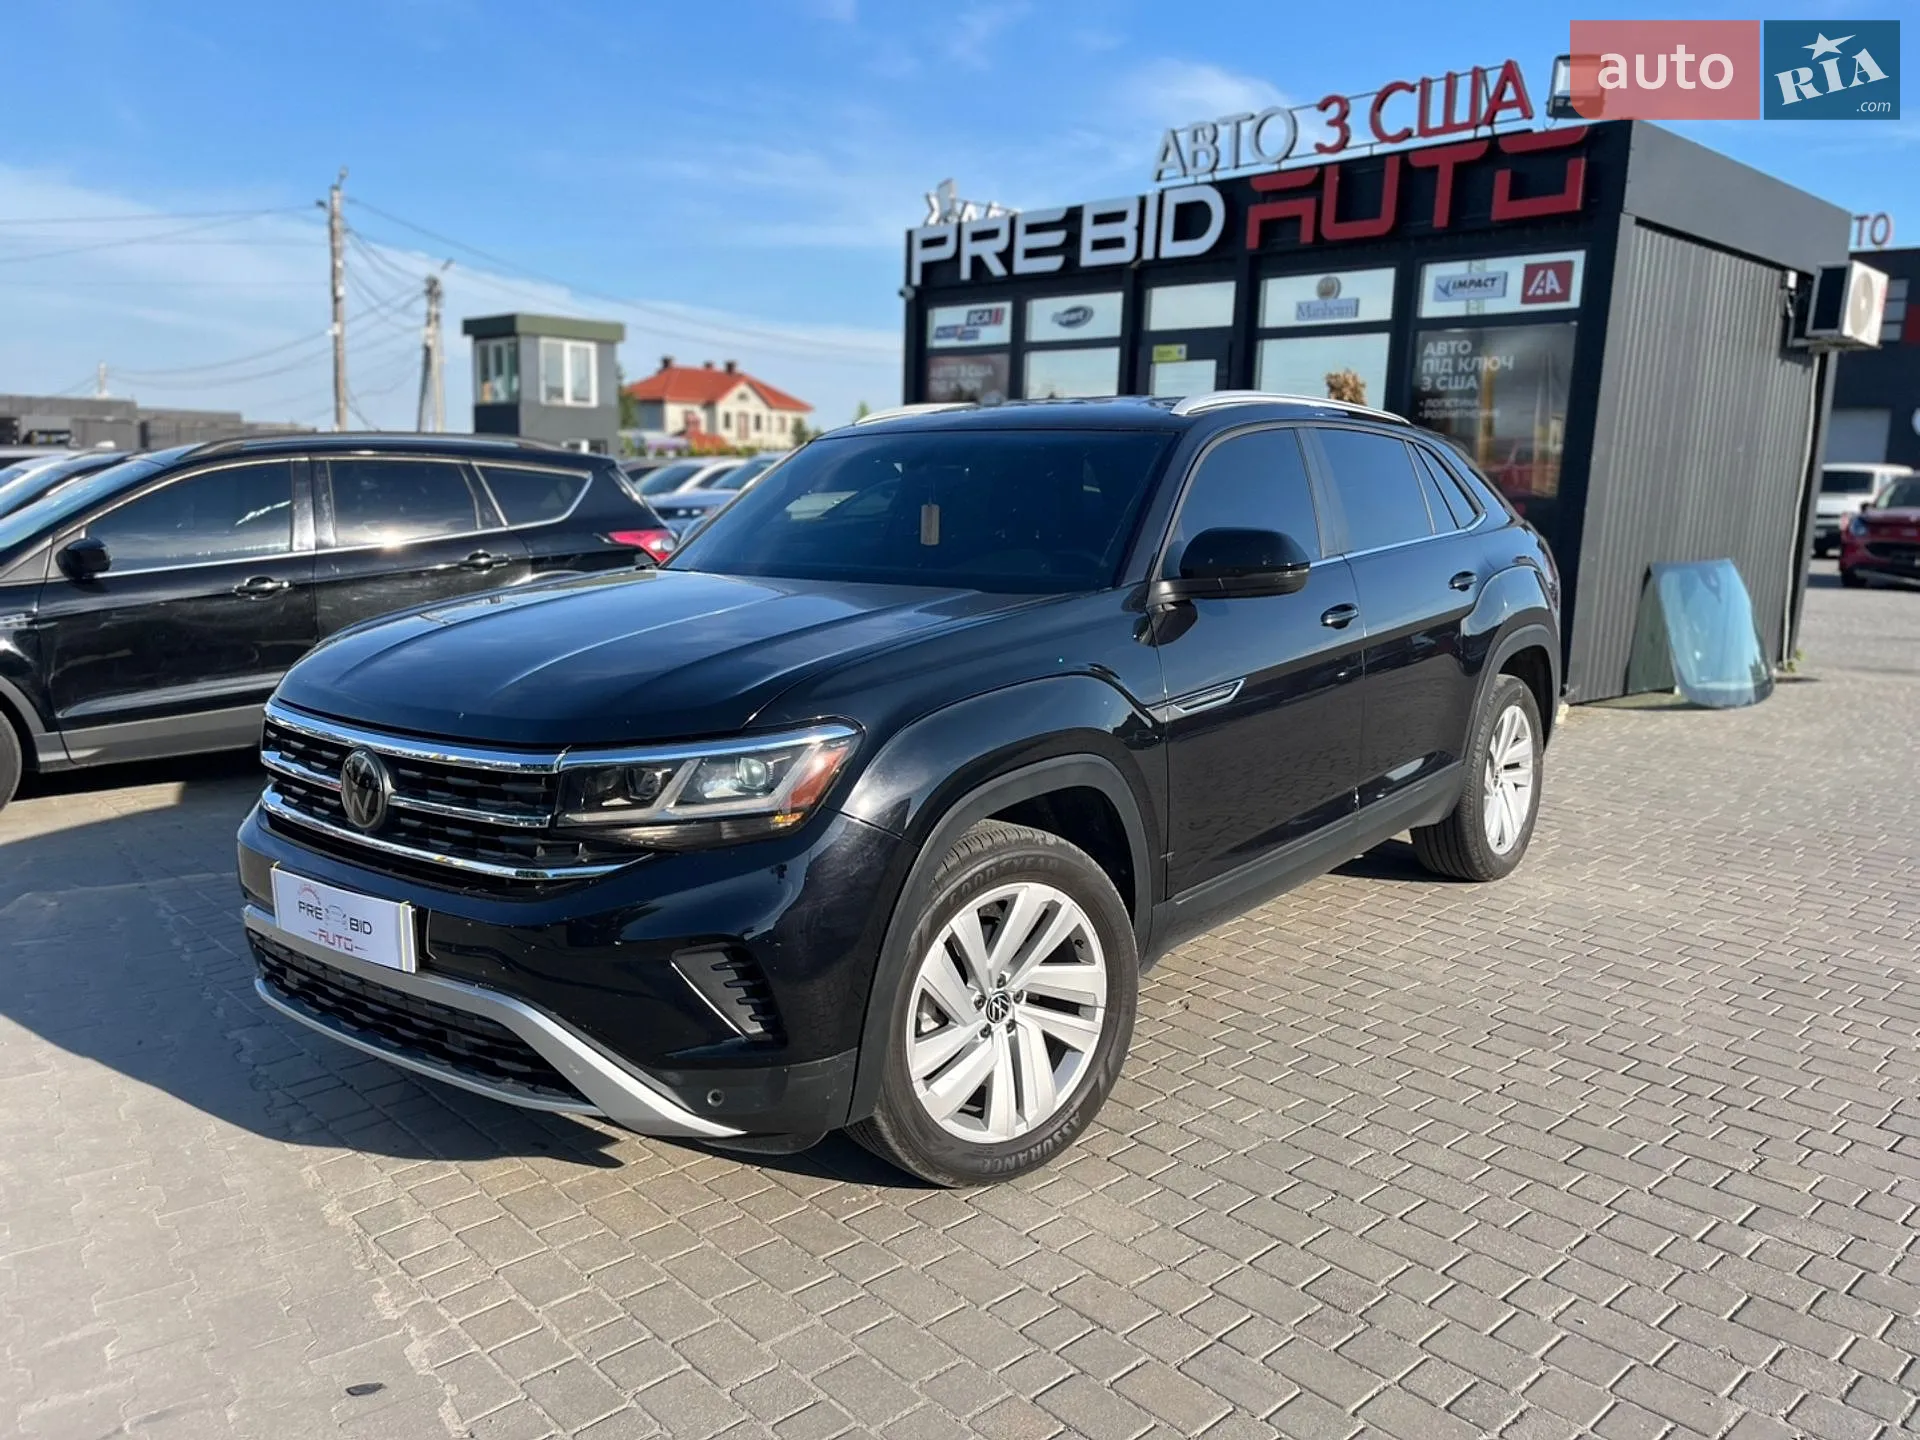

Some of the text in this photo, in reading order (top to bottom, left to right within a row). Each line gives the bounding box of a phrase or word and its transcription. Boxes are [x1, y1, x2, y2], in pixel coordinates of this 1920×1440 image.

[1152, 105, 1298, 182] АВТО
[1369, 59, 1534, 144] США
[1246, 125, 1590, 250] AUTO
[1452, 277, 1499, 290] IMPACT
[1423, 340, 1473, 357] АВТО
[1458, 355, 1515, 373] КЛЮЧ
[1436, 375, 1479, 391] США
[297, 900, 374, 935] PRE BID
